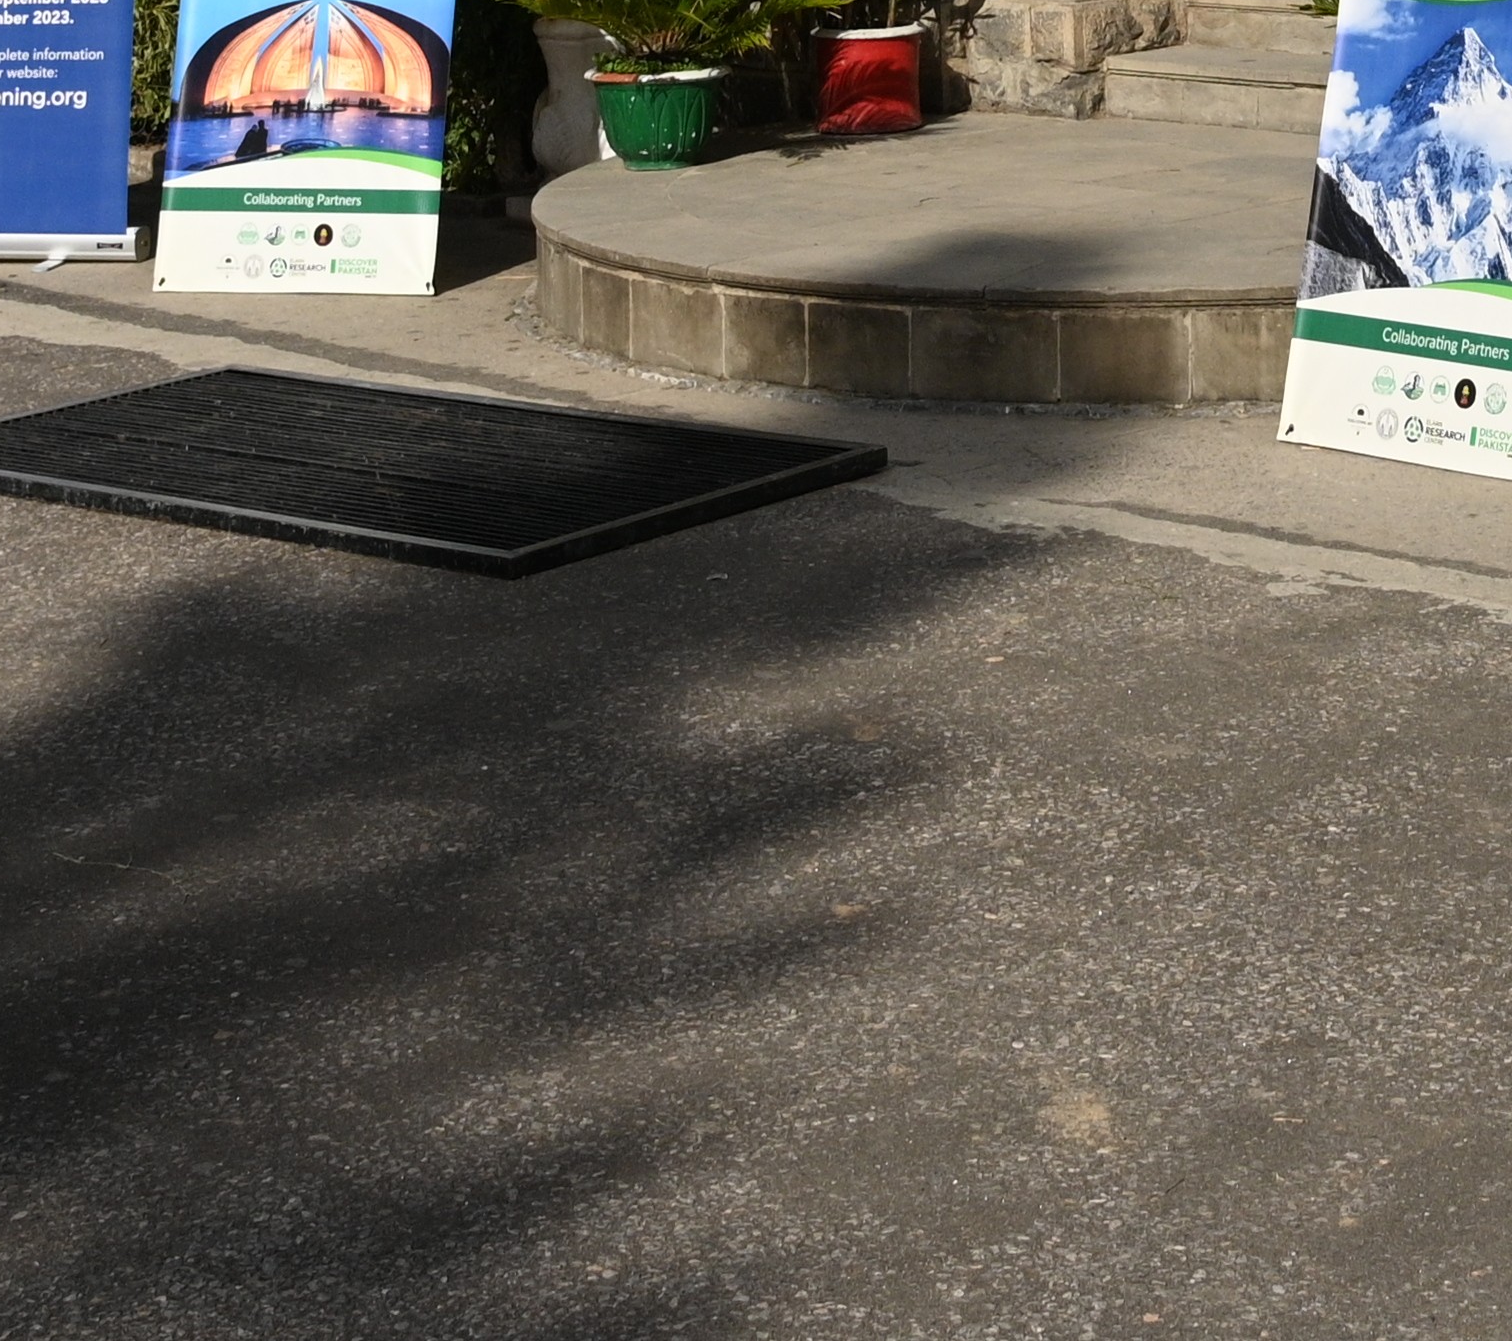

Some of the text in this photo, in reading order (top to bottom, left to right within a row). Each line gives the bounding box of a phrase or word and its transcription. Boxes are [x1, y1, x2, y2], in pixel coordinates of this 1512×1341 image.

[32, 10, 74, 24] 2023.
[33, 48, 103, 61] information
[7, 67, 58, 78] website:
[244, 192, 361, 208] Collaborating Partners
[1382, 327, 1510, 360] Collaborating Partners
[1426, 426, 1465, 442] RESEARCH
